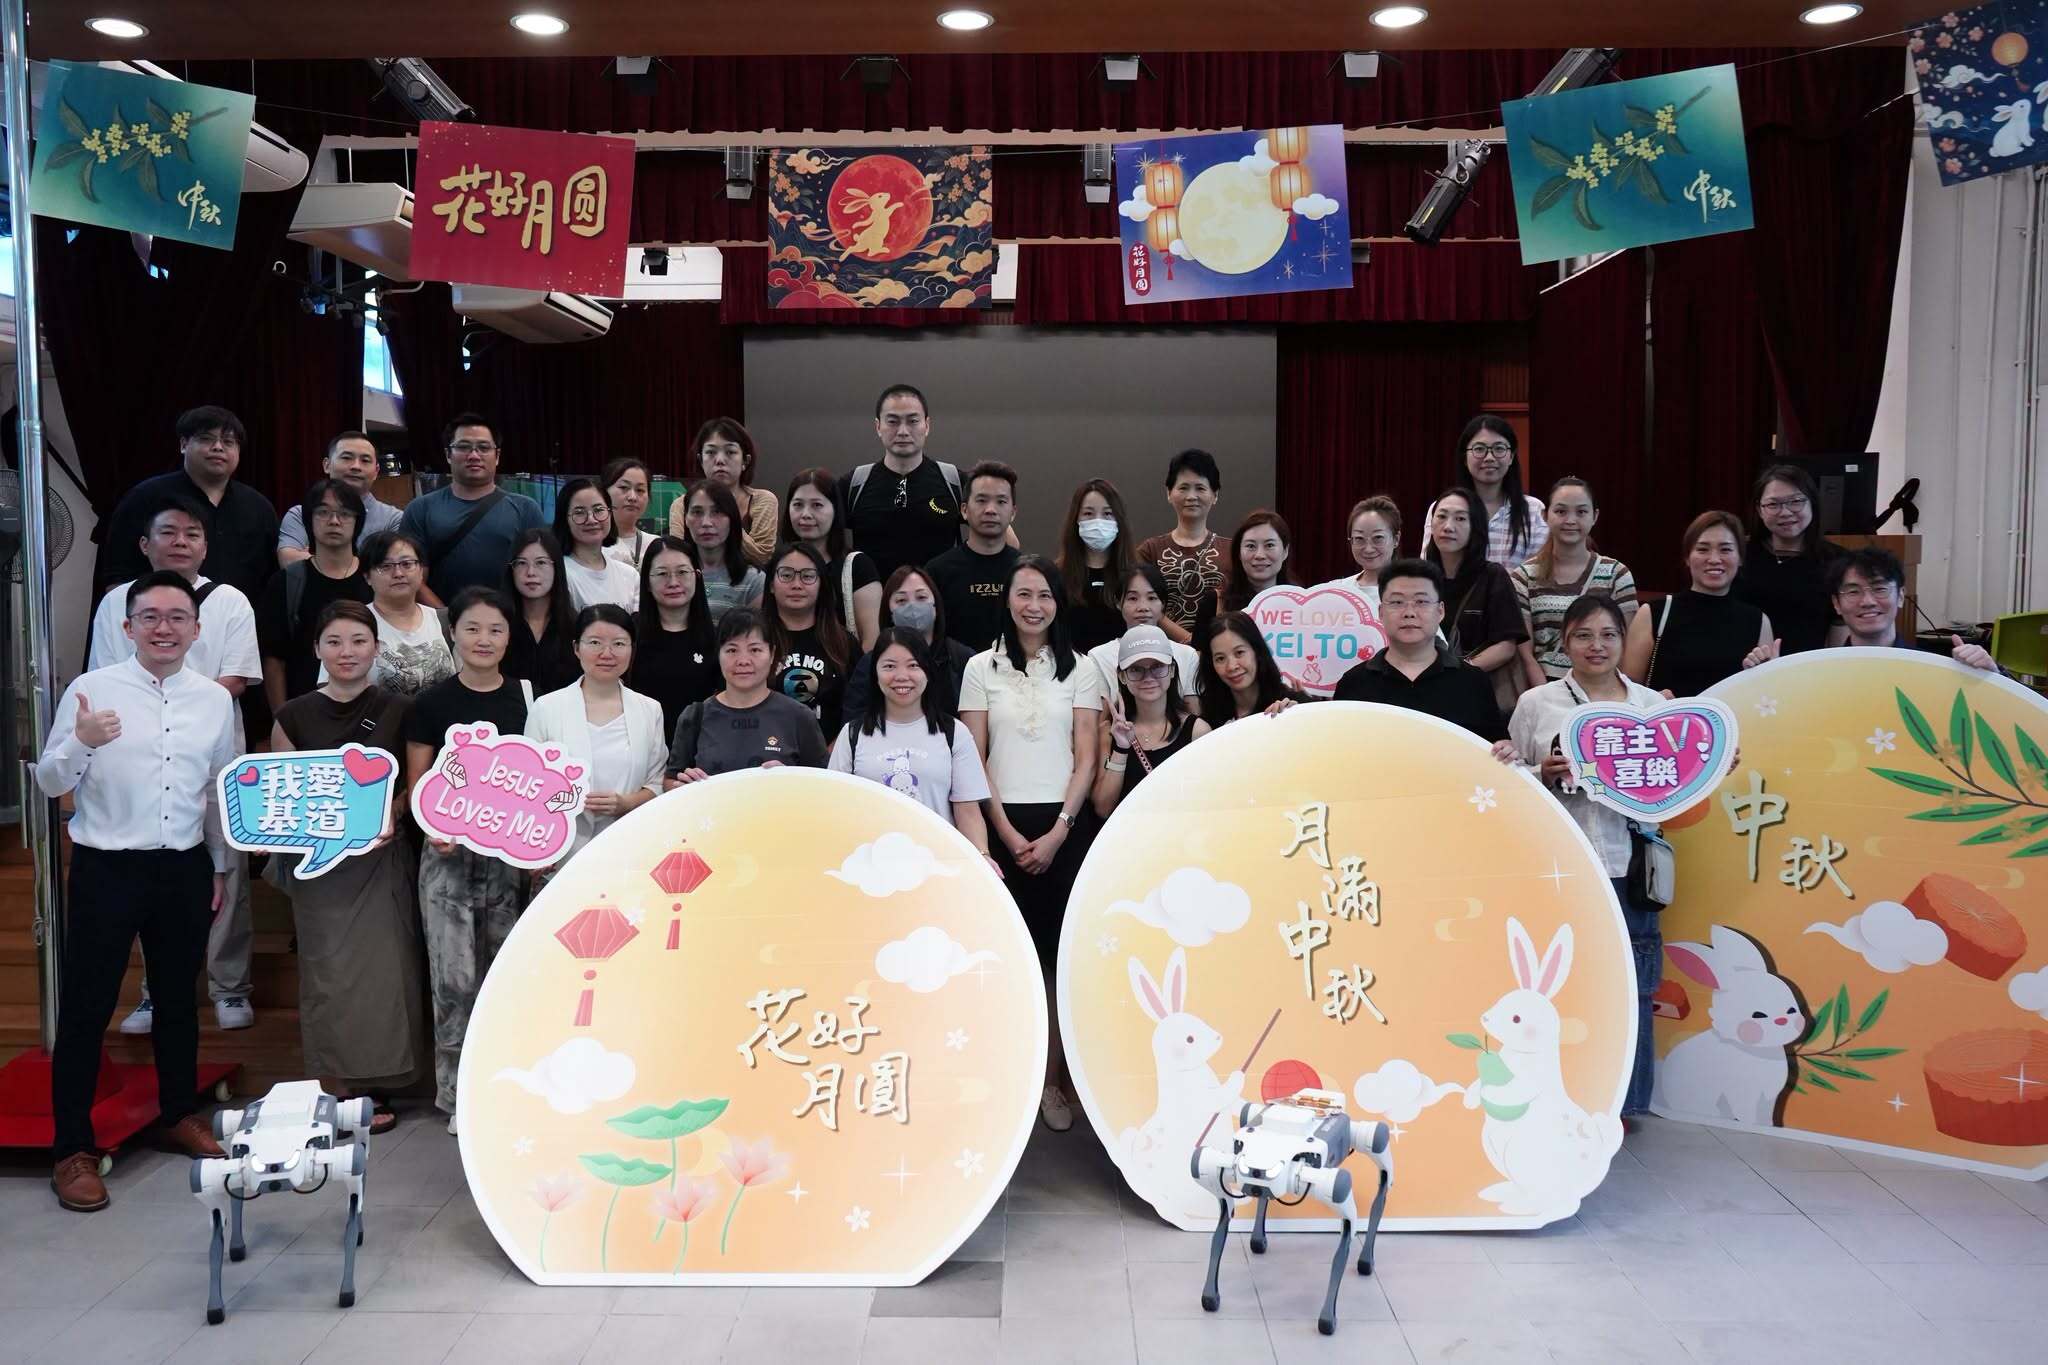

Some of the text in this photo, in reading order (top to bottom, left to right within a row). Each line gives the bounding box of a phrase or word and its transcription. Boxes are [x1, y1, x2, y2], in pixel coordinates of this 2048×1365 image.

[178, 180, 222, 230] 中秋
[1683, 169, 1737, 223] 中秋
[1261, 610, 1354, 627] WE LOVE
[1314, 633, 1358, 660] TO
[1594, 725, 1658, 756] 靠主
[261, 762, 346, 800] 我愛
[480, 755, 545, 801] Jesus
[1614, 757, 1678, 788] 喜樂
[258, 799, 349, 840] 基道
[434, 785, 556, 850] Loves Me!
[1721, 769, 1856, 900] 中秋
